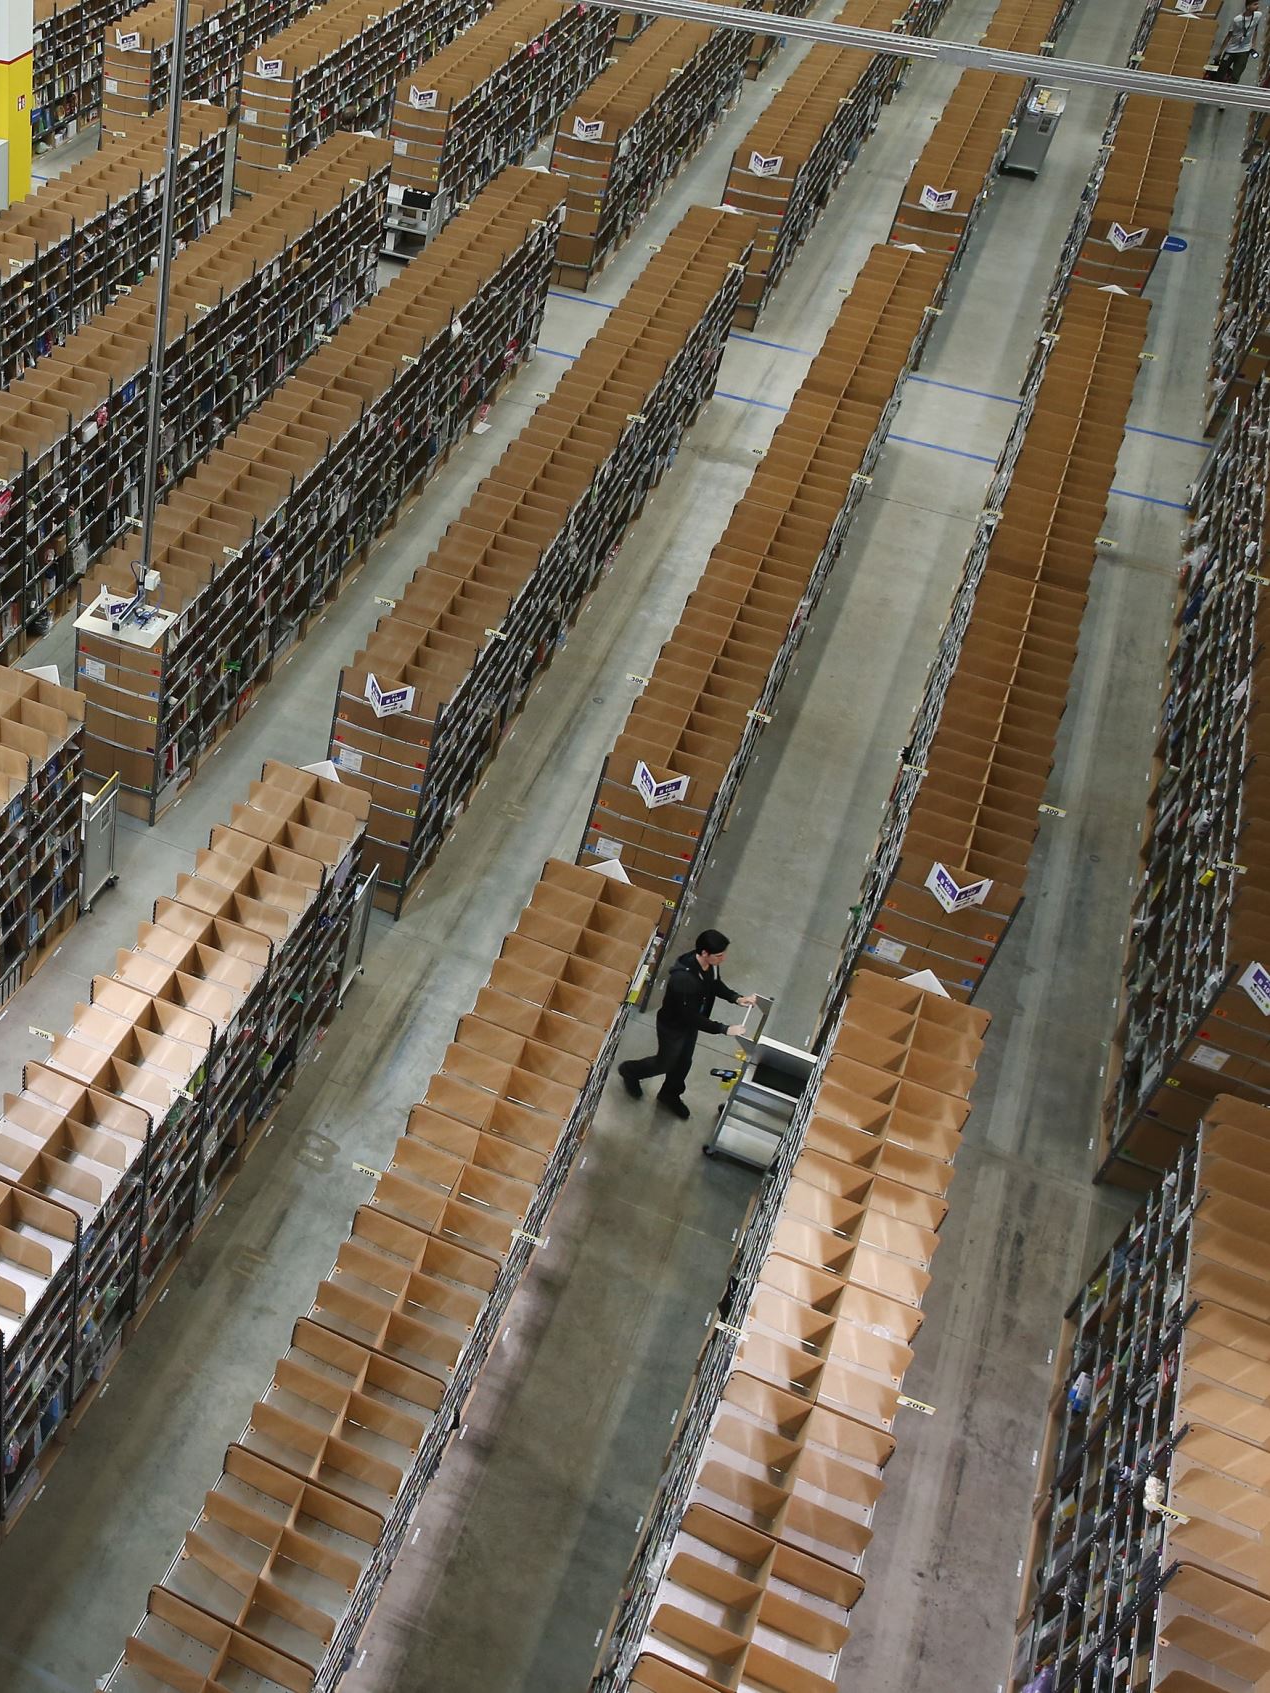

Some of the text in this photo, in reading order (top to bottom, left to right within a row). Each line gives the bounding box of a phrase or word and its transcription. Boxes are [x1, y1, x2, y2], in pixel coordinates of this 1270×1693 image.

[631, 676, 644, 684] 300
[1044, 807, 1058, 816] 300
[1226, 864, 1240, 872] 300
[35, 1030, 48, 1040] 200
[360, 1167, 376, 1178] 200
[520, 1232, 535, 1243] 200
[724, 1326, 740, 1338] 200
[906, 1400, 925, 1412] 200
